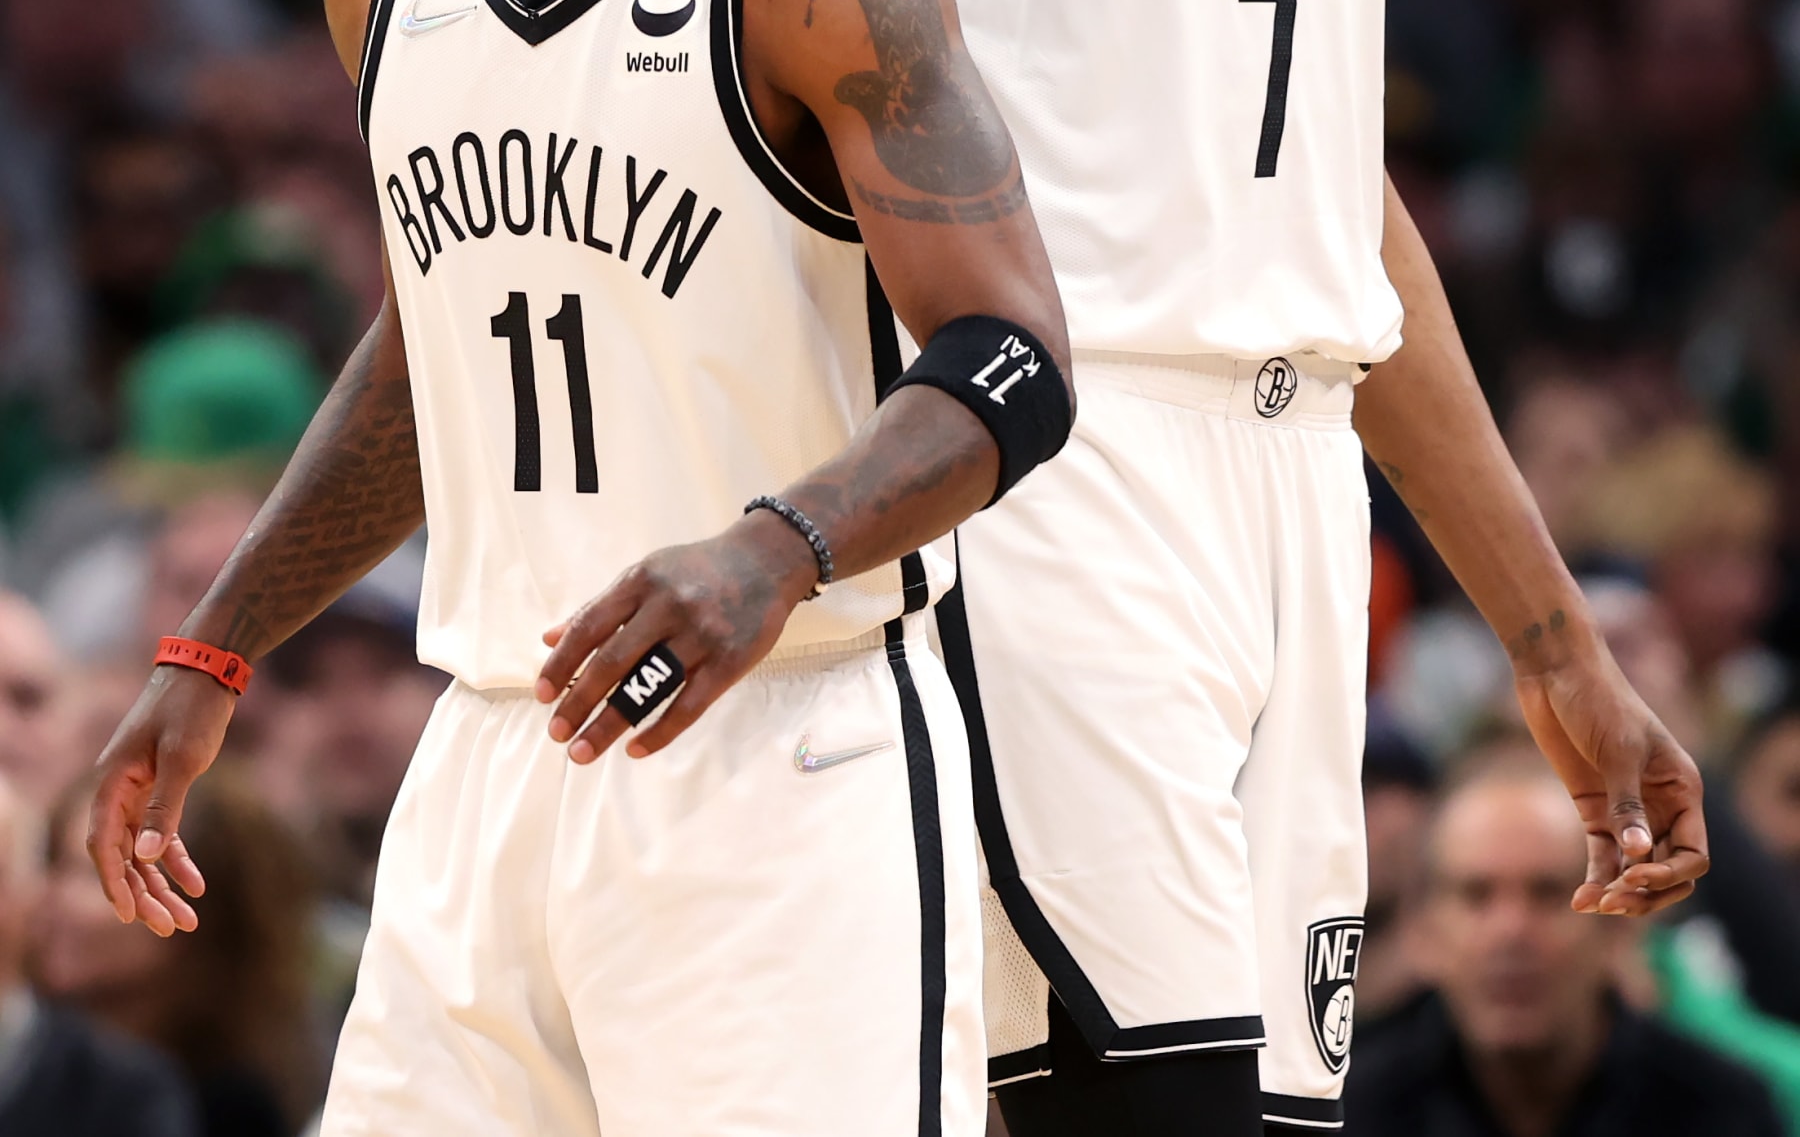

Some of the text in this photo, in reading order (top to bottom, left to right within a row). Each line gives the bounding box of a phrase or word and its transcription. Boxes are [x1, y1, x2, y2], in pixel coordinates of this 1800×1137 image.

[626, 51, 689, 73] Webull
[386, 128, 722, 300] BROOKLYN
[970, 352, 1025, 405] 11
[1000, 335, 1041, 378] KAI
[490, 291, 599, 494] 11
[623, 655, 673, 706] KAI
